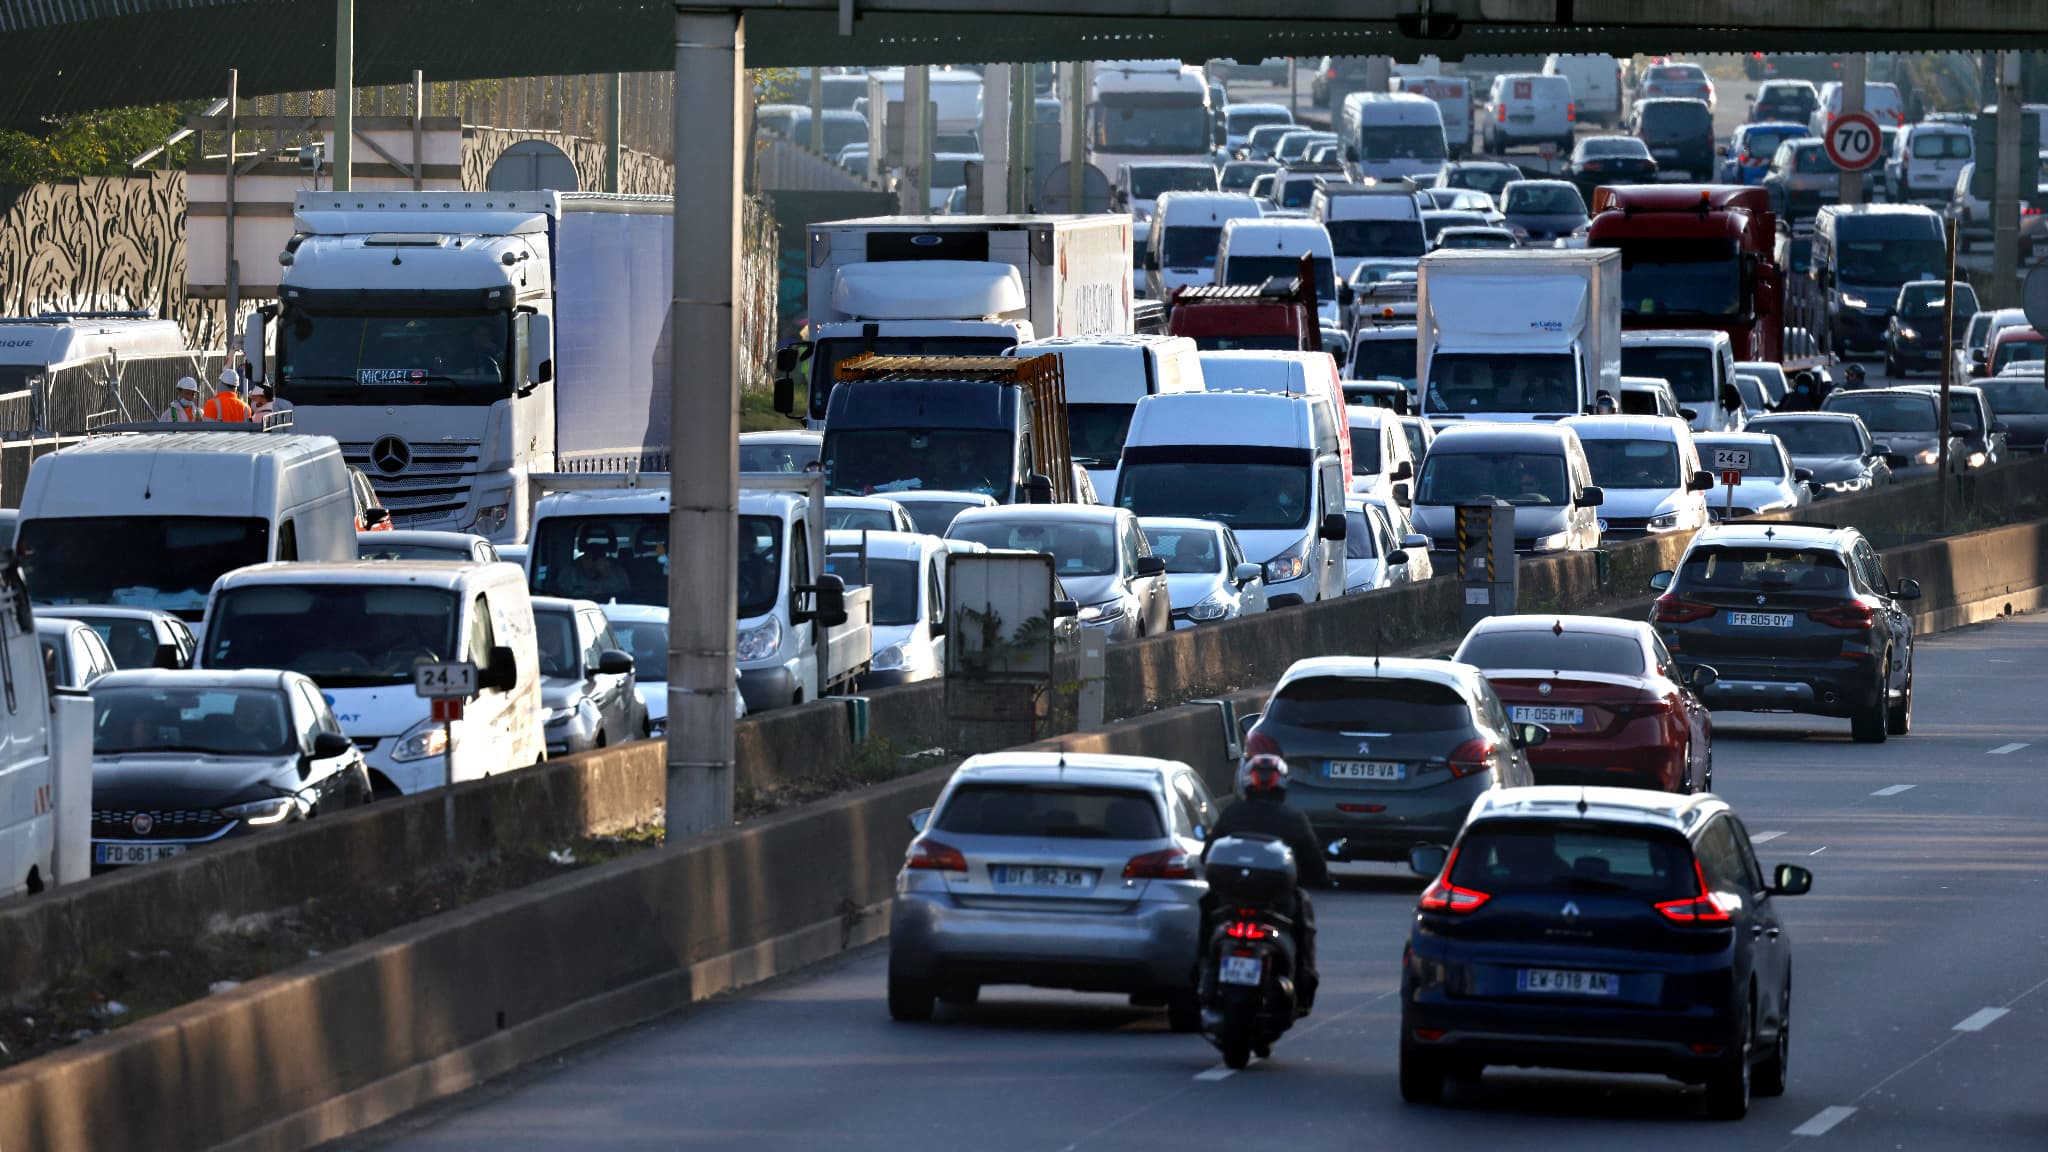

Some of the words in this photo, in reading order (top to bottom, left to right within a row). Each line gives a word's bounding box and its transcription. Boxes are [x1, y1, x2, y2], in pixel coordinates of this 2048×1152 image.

[1838, 130, 1870, 153] 70
[361, 370, 410, 384] MICKAEL
[1719, 452, 1746, 464] 24.2
[423, 668, 469, 686] 24.1
